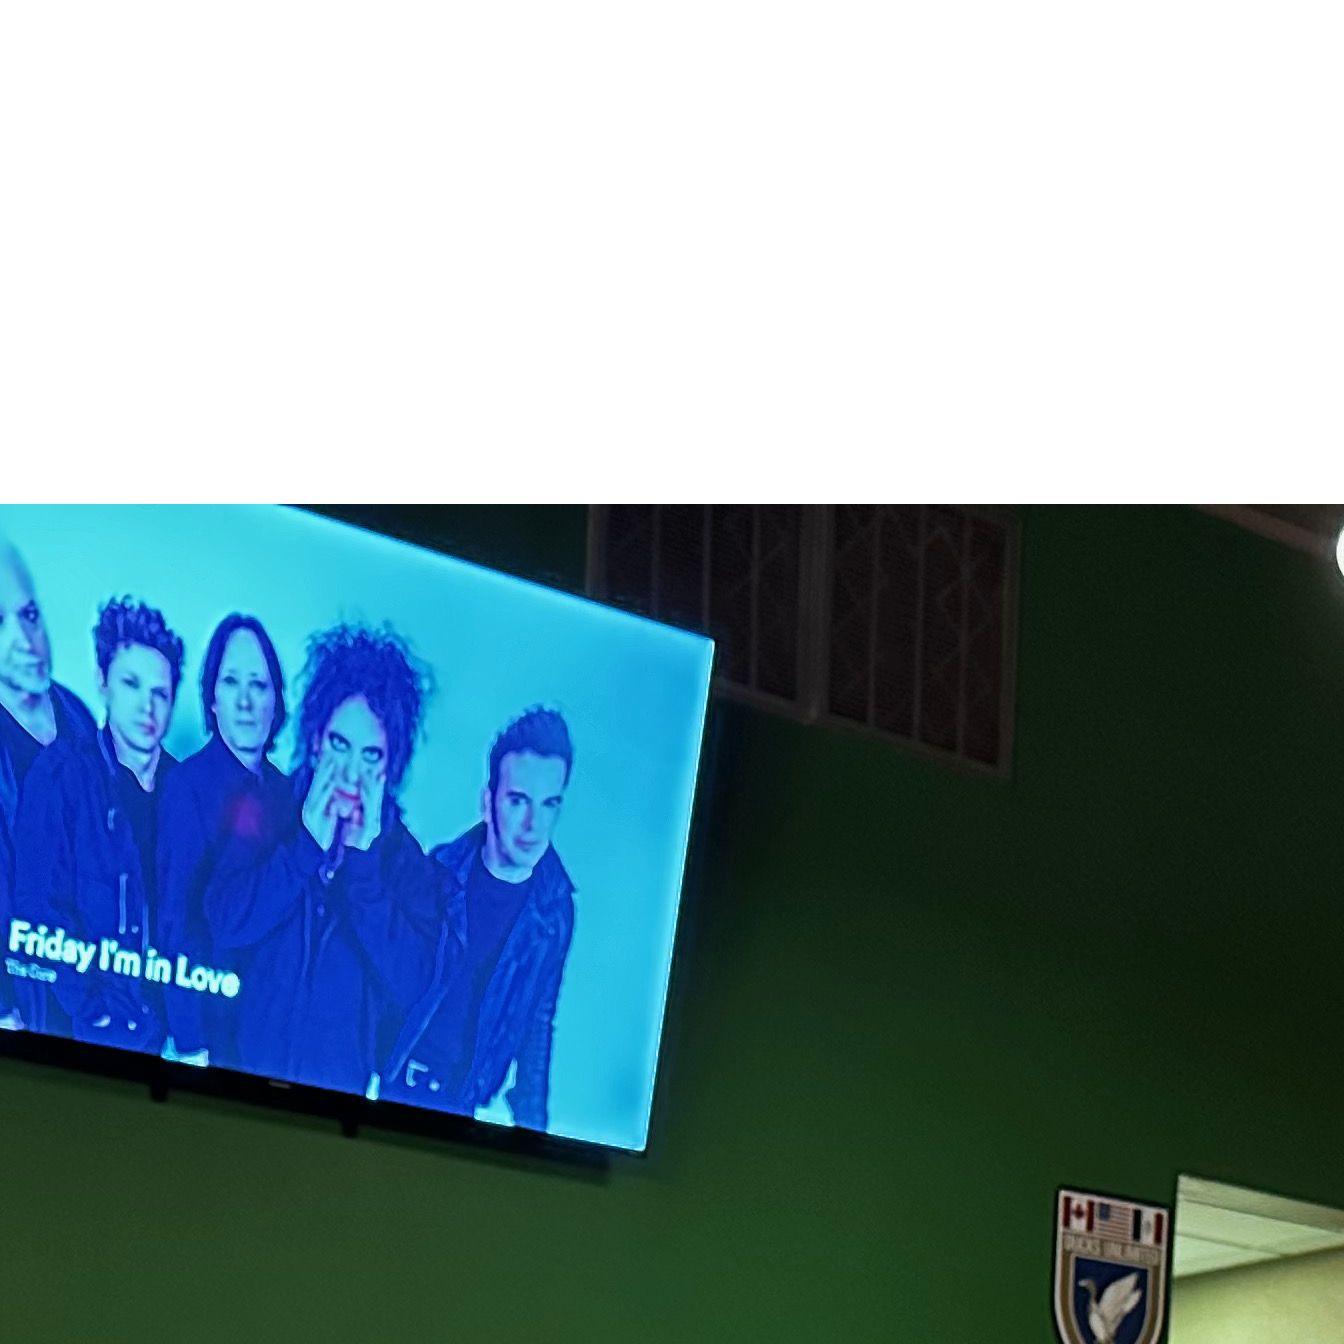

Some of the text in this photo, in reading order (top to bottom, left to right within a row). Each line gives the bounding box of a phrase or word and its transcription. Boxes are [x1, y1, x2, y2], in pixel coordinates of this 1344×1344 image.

[9, 918, 241, 998] Friday I'm in Love
